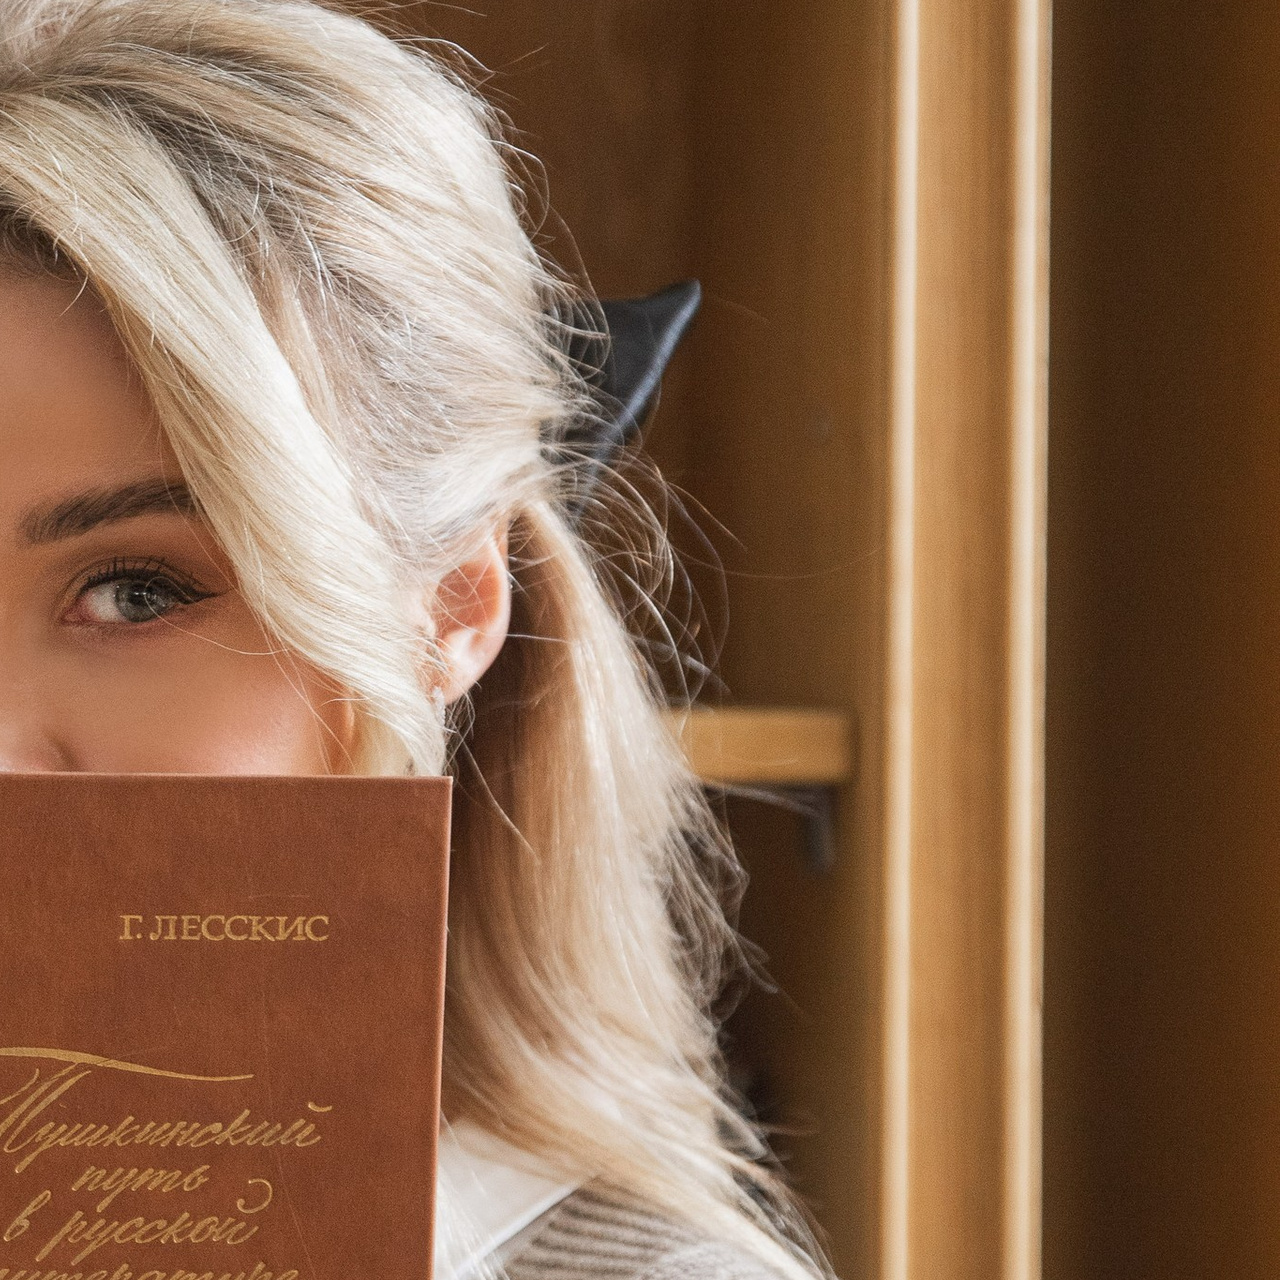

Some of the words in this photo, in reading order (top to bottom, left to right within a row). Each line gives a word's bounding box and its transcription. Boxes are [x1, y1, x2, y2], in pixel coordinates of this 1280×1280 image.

[120, 914, 144, 941] Г.
[149, 914, 331, 943] ЛЕССКИС
[70, 1162, 211, 1213] путь
[2, 1189, 53, 1253] в
[35, 1178, 274, 1267] русской
